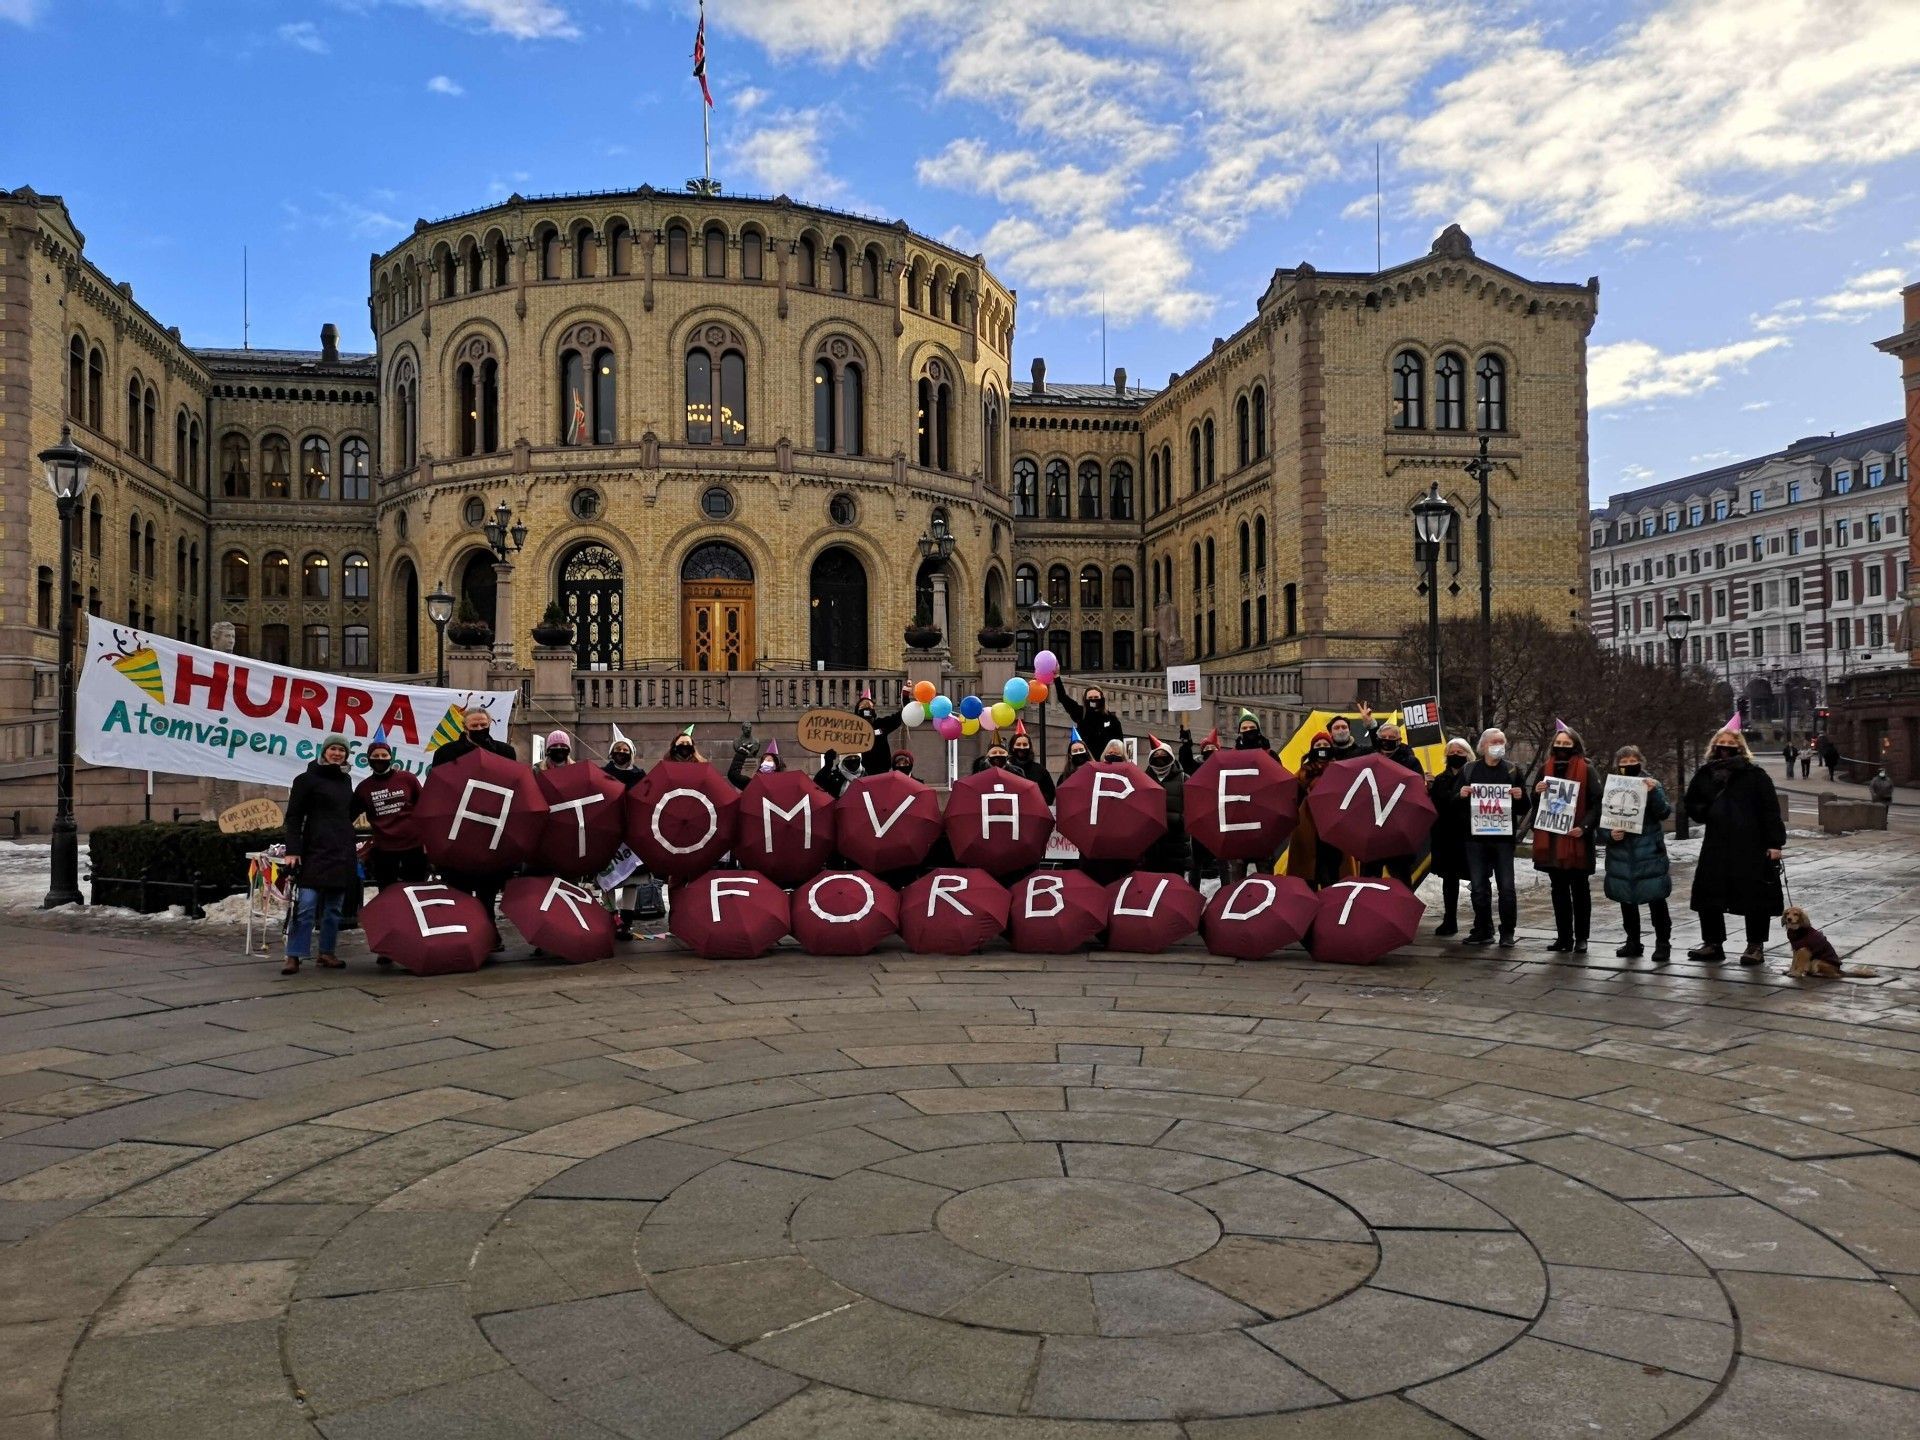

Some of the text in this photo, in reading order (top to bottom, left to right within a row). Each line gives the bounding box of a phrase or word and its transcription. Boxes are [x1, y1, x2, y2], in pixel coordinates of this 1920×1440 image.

[173, 653, 420, 745] HURRA
[101, 699, 288, 759] Atomvåpen
[1472, 785, 1509, 799] NORGE
[1479, 798, 1504, 815] MÅ
[1473, 814, 1509, 828] SIGNERE
[1536, 809, 1573, 832] AVTALEN
